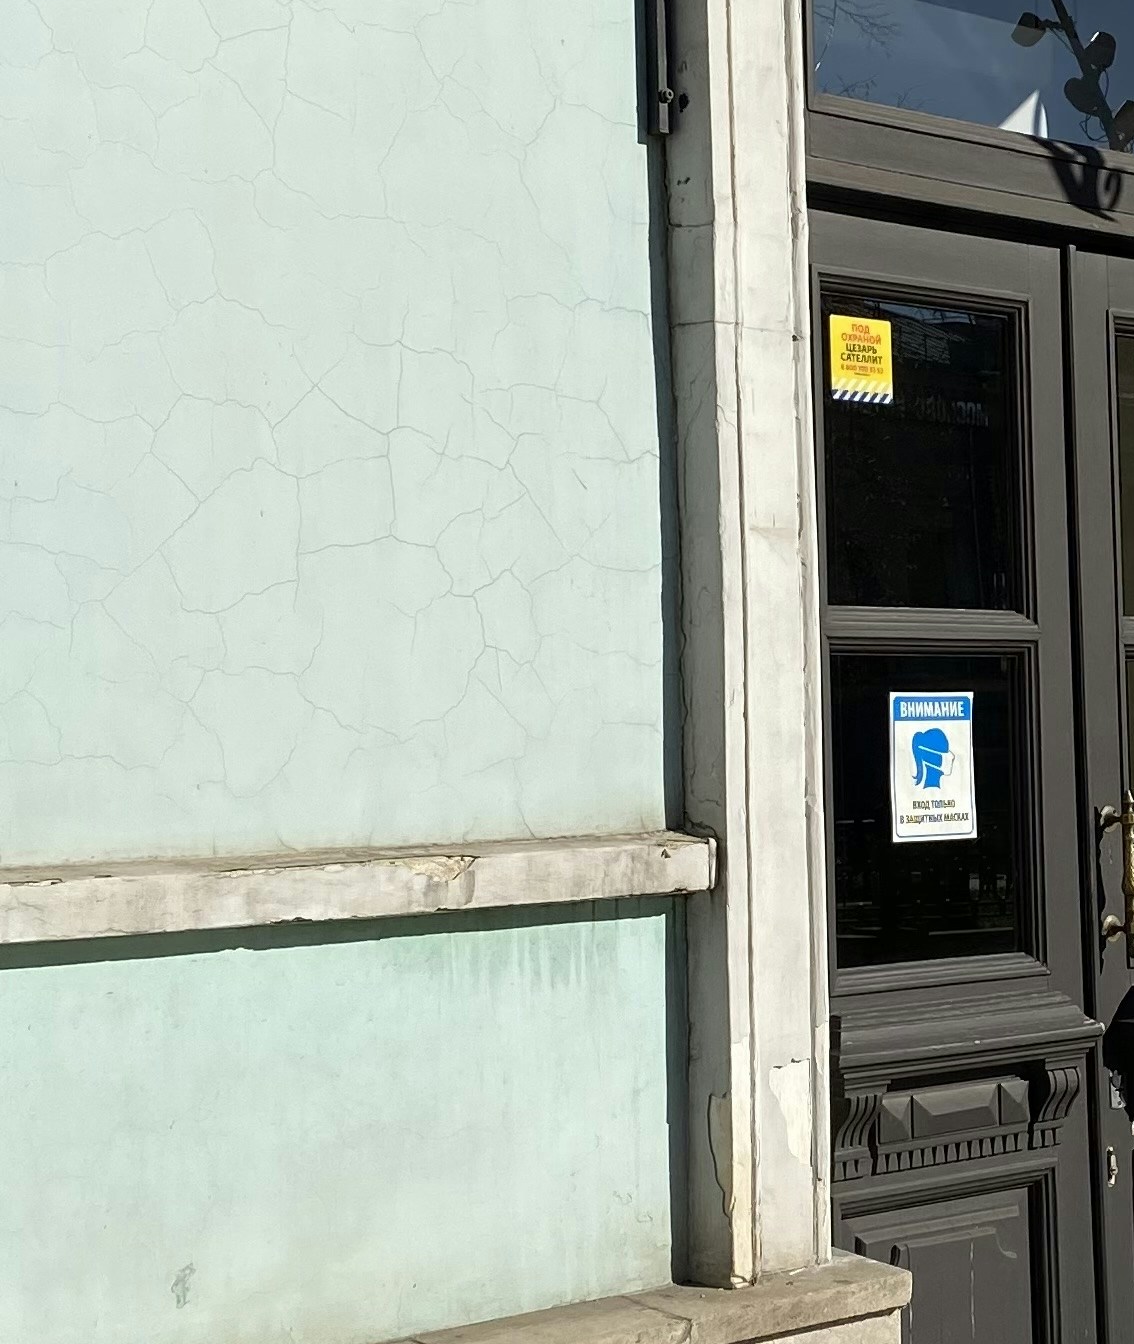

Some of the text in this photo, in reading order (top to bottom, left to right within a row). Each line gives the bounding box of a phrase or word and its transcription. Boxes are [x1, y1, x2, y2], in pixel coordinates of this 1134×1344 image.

[852, 324, 870, 334] ПОД
[841, 332, 881, 345] ОХРАНОЙ
[846, 343, 877, 354] ЦЕЗАРЬ
[840, 352, 883, 365] САТЕЛЛИТ
[900, 701, 964, 718] ВНИМАНИЕ
[912, 799, 956, 811] ВХОД ТОЛЬКО
[900, 812, 969, 824] В ЗАЩИТНЫХ МАСКАХ
